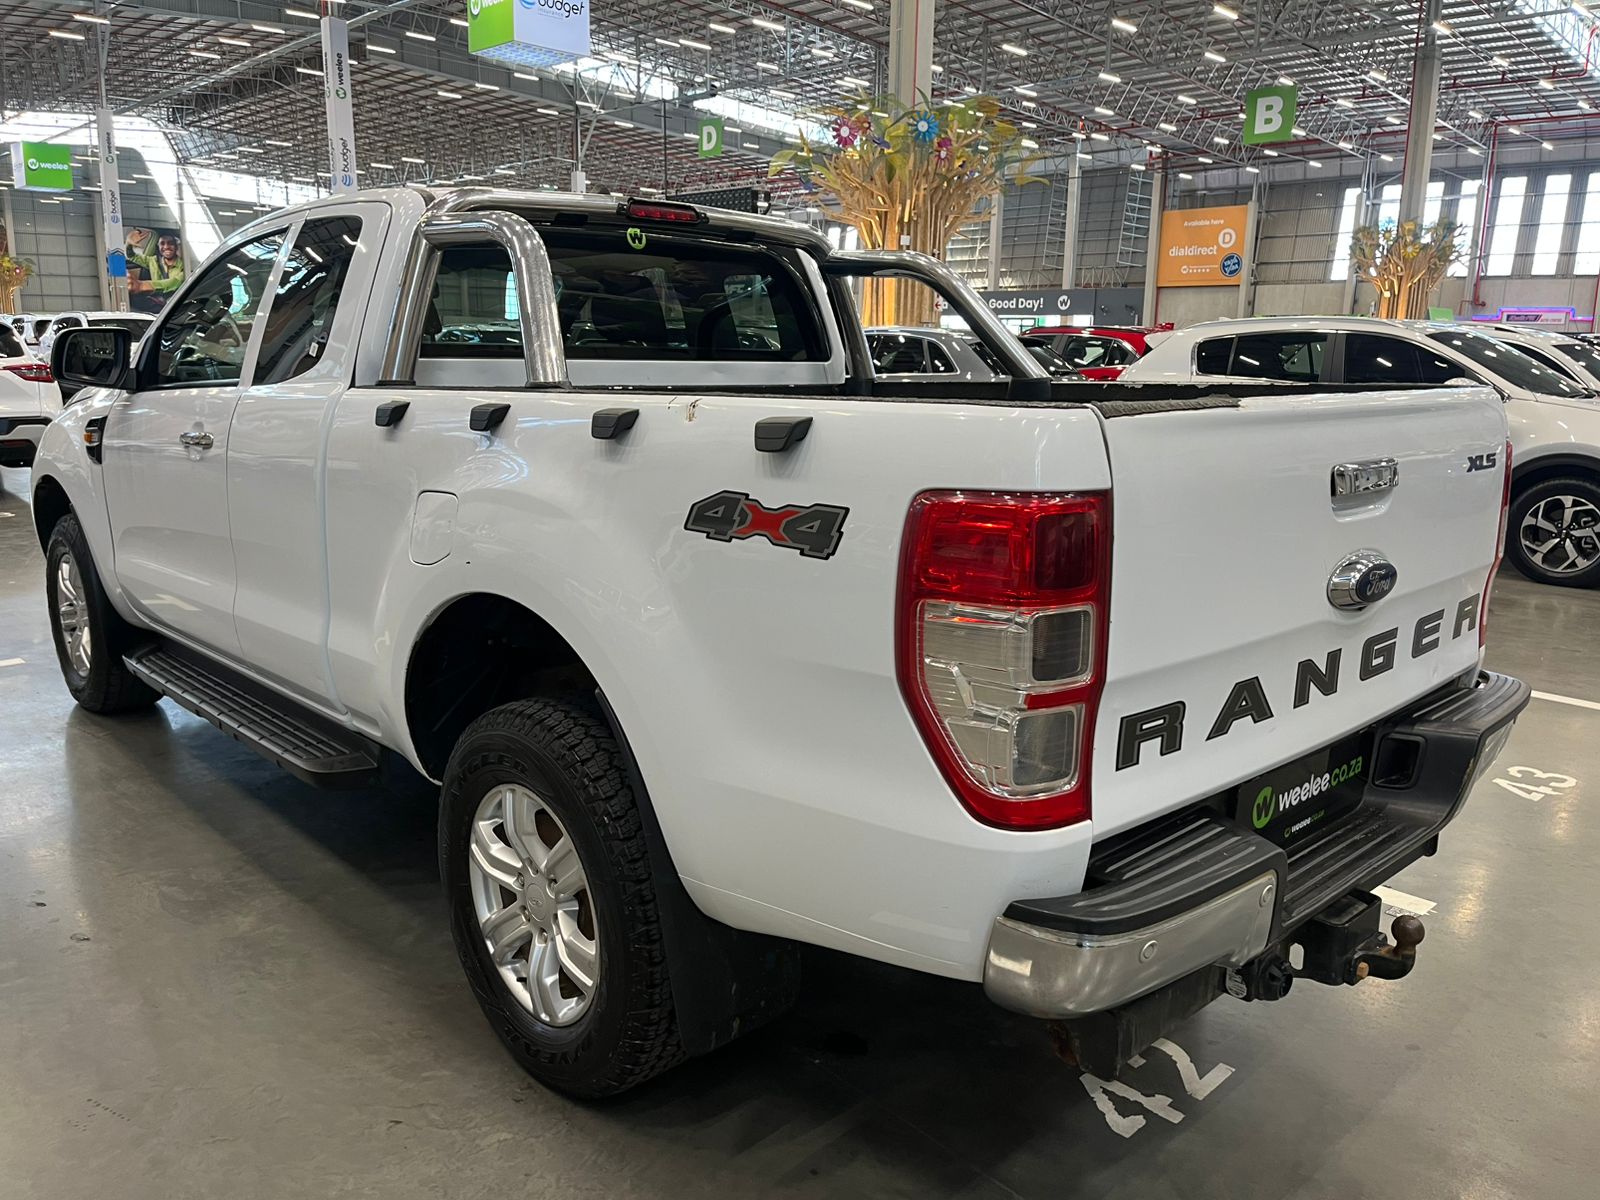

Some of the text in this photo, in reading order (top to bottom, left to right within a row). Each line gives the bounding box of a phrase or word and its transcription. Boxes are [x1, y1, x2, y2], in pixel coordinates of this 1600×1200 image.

[1254, 95, 1284, 135] B
[702, 125, 717, 151] D
[40, 162, 69, 171] weelee
[341, 137, 352, 173] budget
[1168, 244, 1217, 257] dialdirect
[988, 298, 1016, 309] Good
[1018, 297, 1044, 311] Day!
[1466, 452, 1497, 473] XLS
[1366, 568, 1392, 596] Ford
[1115, 592, 1481, 772] RANGER
[1278, 755, 1363, 812] weelee.co.za
[1491, 765, 1578, 802] 43
